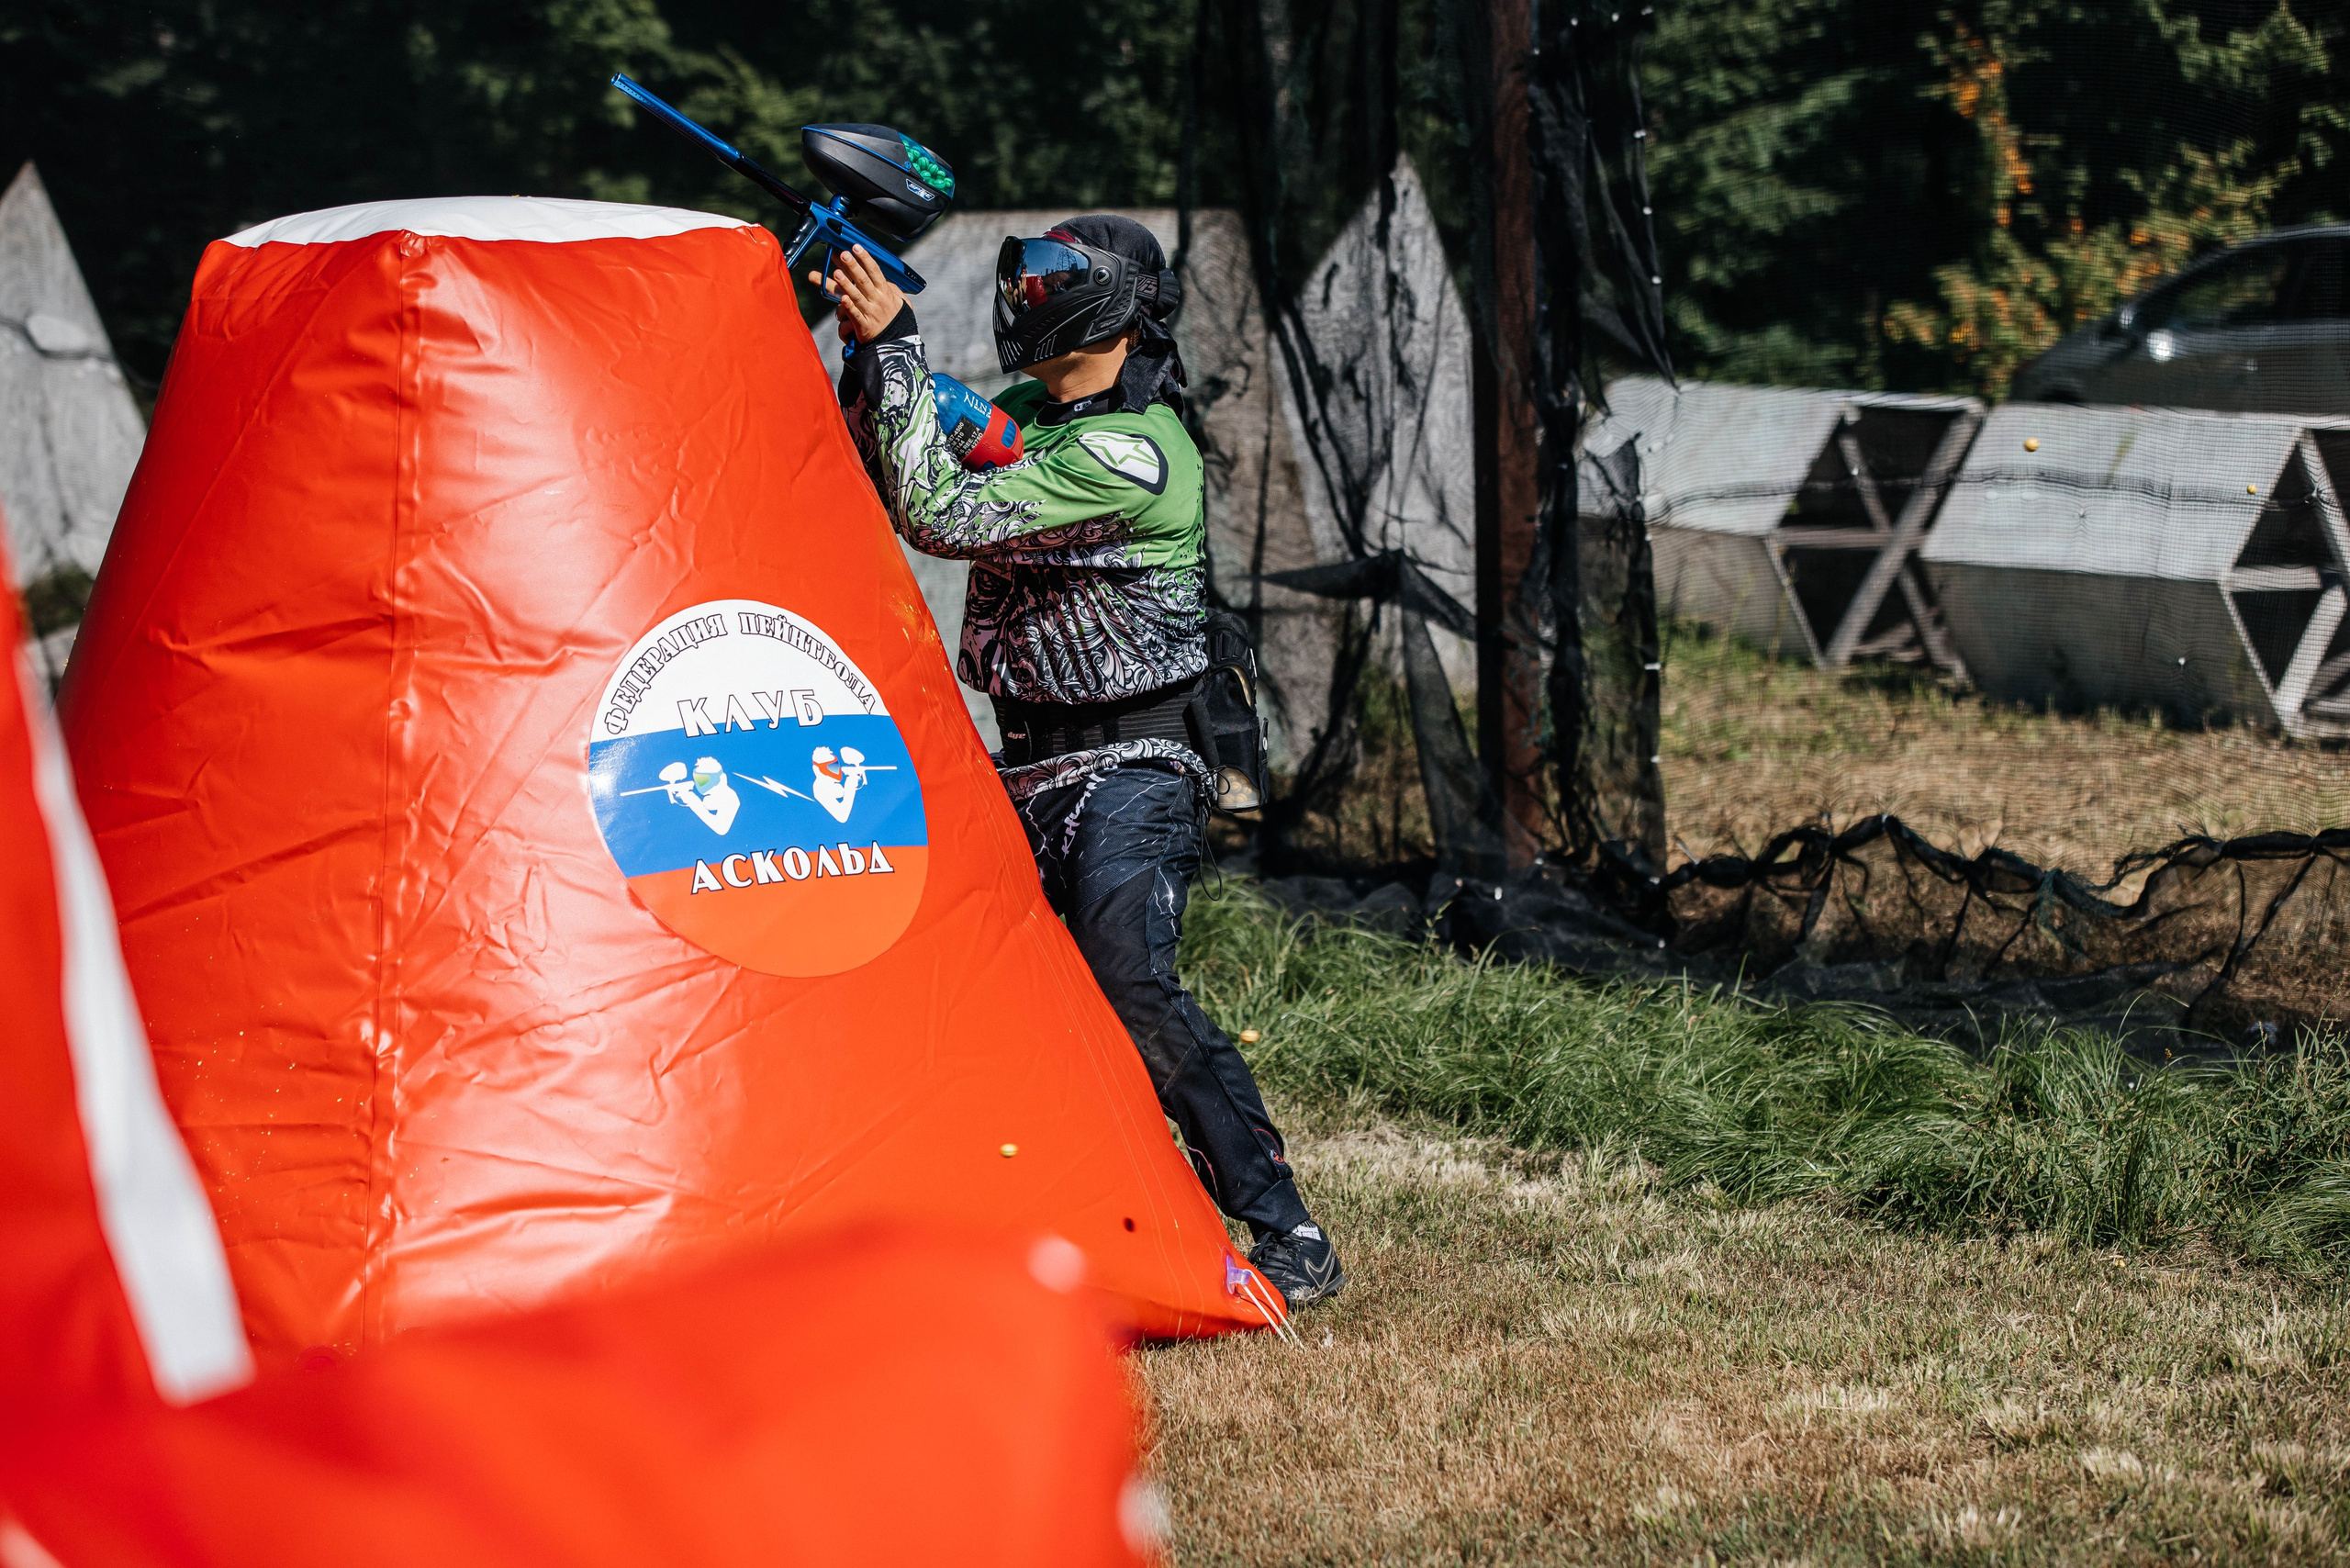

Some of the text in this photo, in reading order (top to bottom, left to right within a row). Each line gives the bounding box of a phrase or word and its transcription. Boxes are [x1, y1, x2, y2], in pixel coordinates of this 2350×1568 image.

[963, 391, 992, 418] NINJ
[604, 612, 878, 735] ФЕДЕРАЦИЯ ПЕЙНТБОЛА
[677, 689, 825, 738] КЛУБ
[690, 840, 895, 896] АСКОЛЬД
